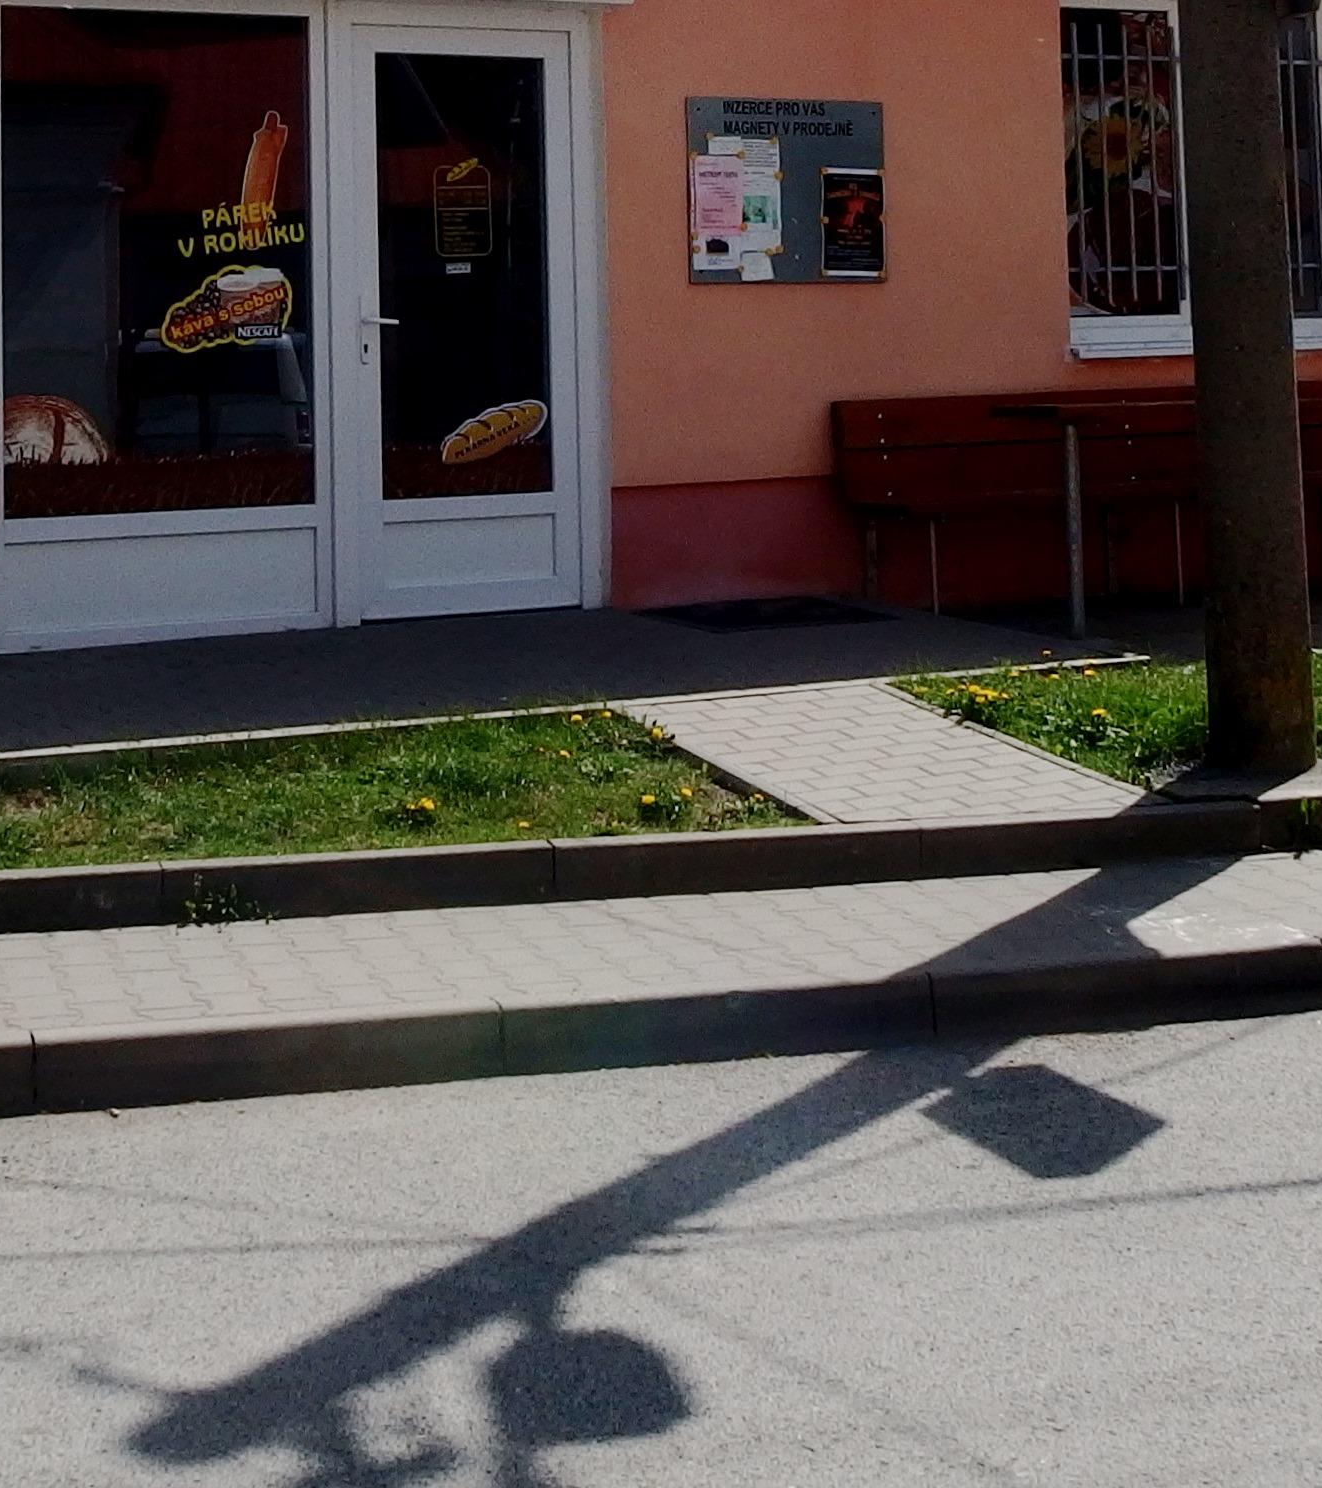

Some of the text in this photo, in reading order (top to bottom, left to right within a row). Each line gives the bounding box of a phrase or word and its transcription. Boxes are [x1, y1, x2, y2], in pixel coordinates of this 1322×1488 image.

[723, 101, 772, 115] INZERCE
[776, 102, 799, 116] PRO
[723, 120, 853, 136] MAGNETY V PRODEJNĚ
[202, 202, 277, 229] PÁREK
[177, 221, 305, 258] V ROHLÍKU
[171, 287, 285, 339] káva s sebou
